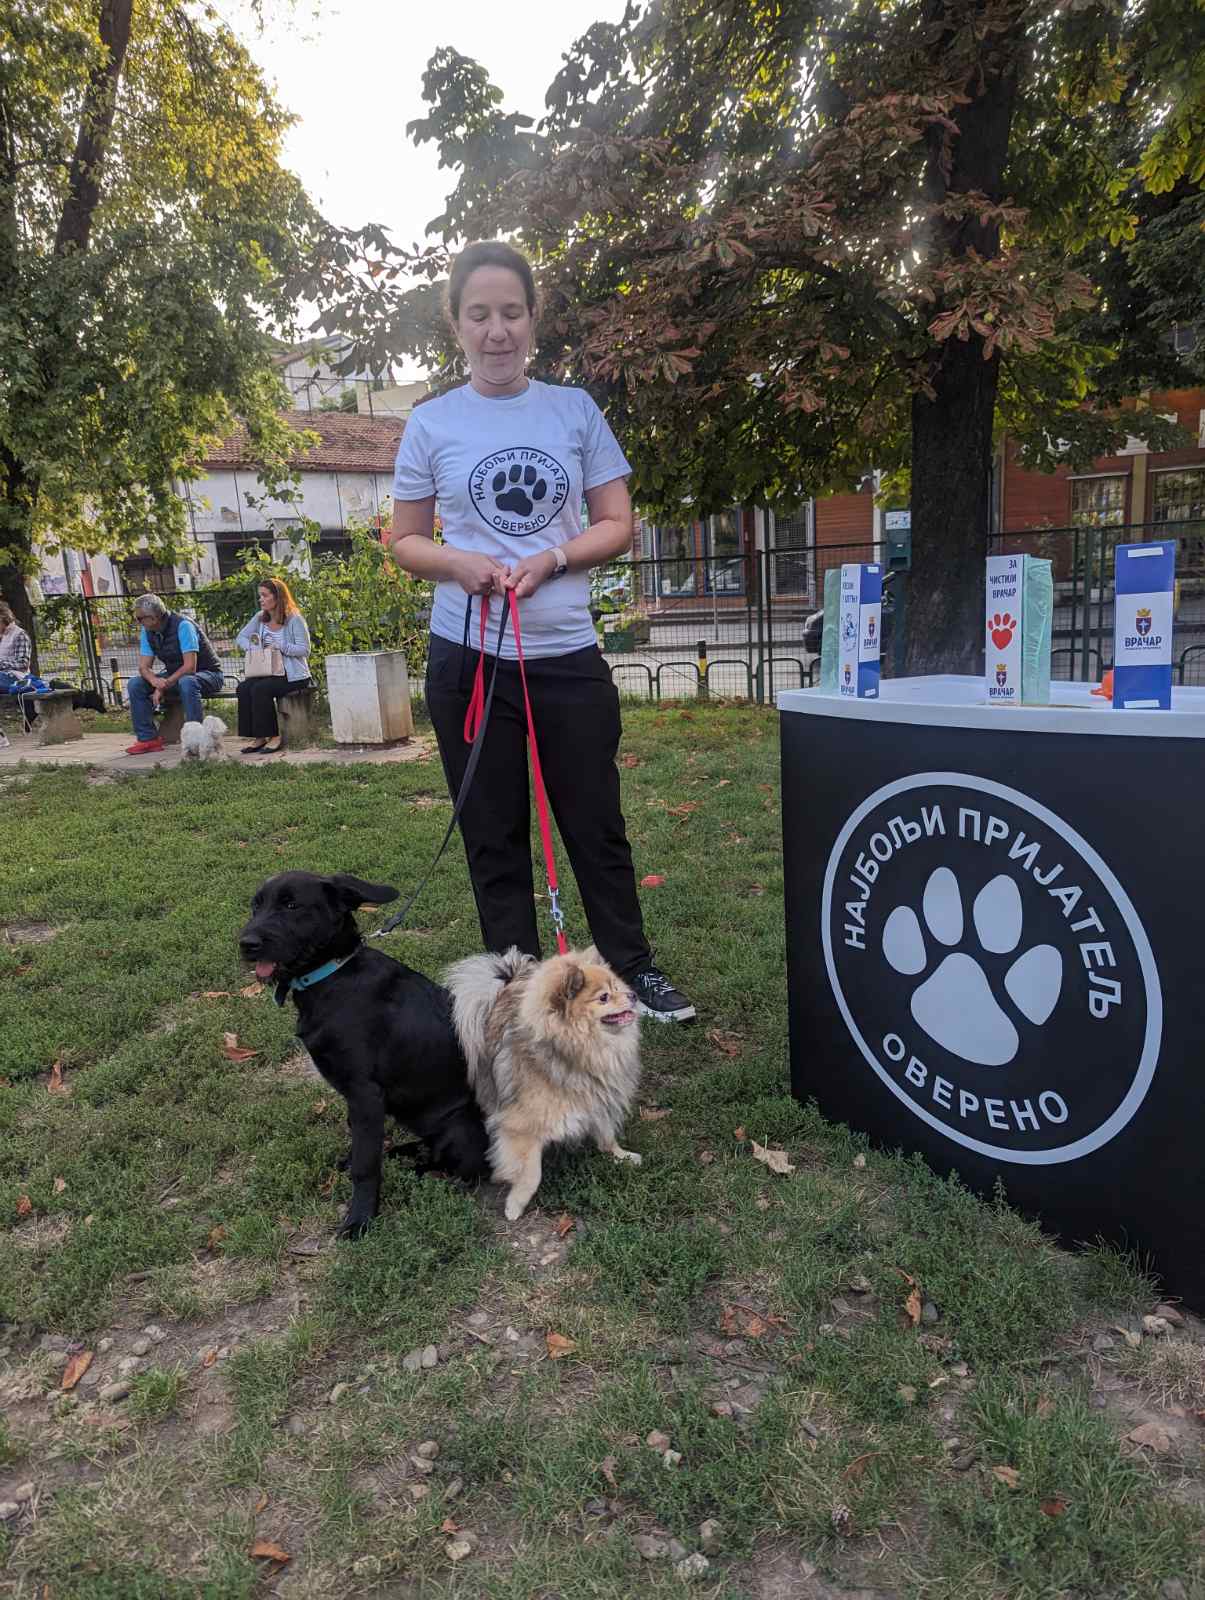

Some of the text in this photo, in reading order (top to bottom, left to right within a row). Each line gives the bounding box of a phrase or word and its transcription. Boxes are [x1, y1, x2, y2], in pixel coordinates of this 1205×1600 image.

[473, 451, 566, 504] НАЈБОЉИ ПРИЈАТЕЉ
[493, 514, 546, 532] ОВЕРЕНО
[992, 588, 1017, 600] ВРАЧАР
[1124, 636, 1162, 647] ВРАЧАР
[989, 687, 1015, 697] ВРАЧАР
[845, 805, 1122, 1019] НАЈБОЉИ ПРИЈАТЕЉ
[883, 1033, 1069, 1131] ОВЕРЕНО
